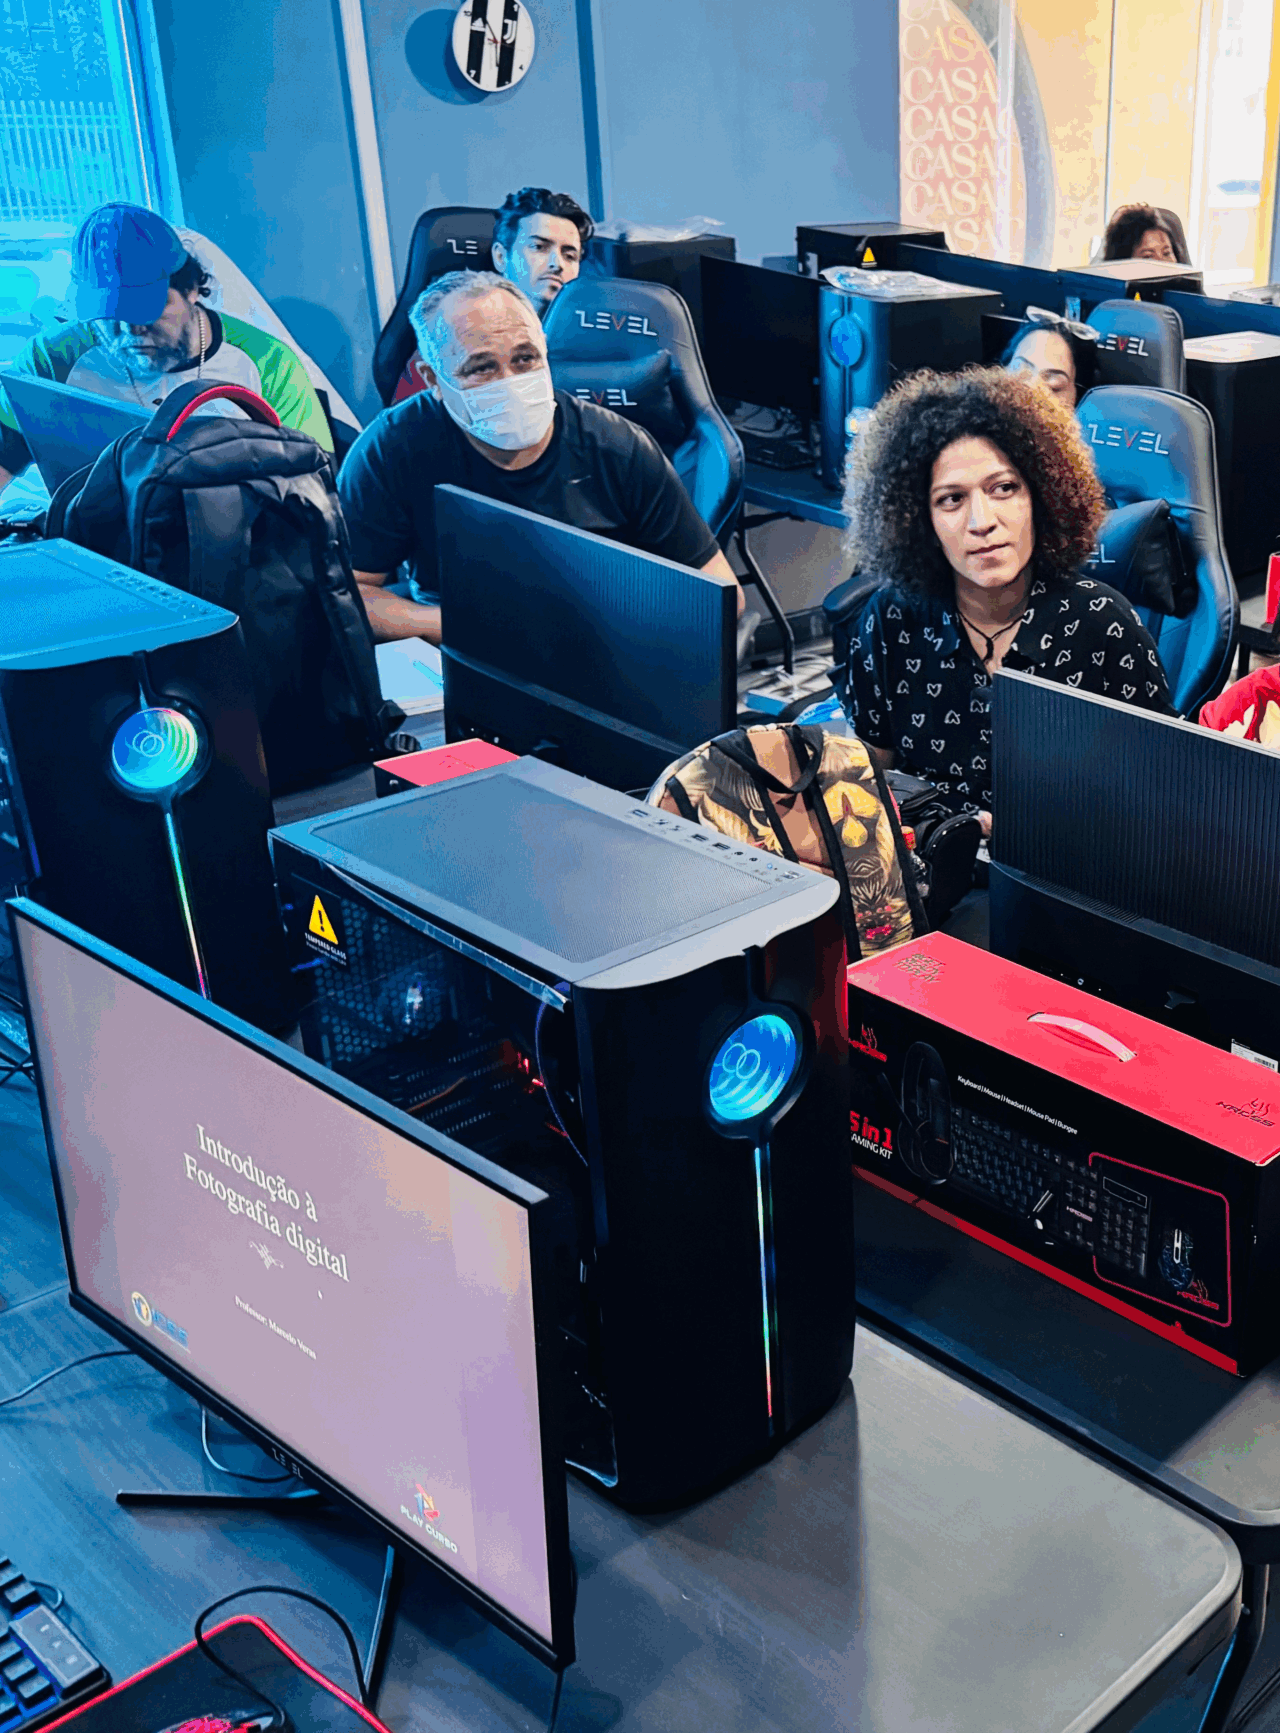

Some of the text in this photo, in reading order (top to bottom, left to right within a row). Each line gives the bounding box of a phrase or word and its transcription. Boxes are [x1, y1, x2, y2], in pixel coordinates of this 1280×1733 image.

[862, 1116, 880, 1143] in
[850, 1132, 893, 1160] AMING KIT
[196, 1123, 319, 1223] Introdução à
[183, 1152, 350, 1283] Fotografia digital
[400, 1503, 424, 1528] PLAY
